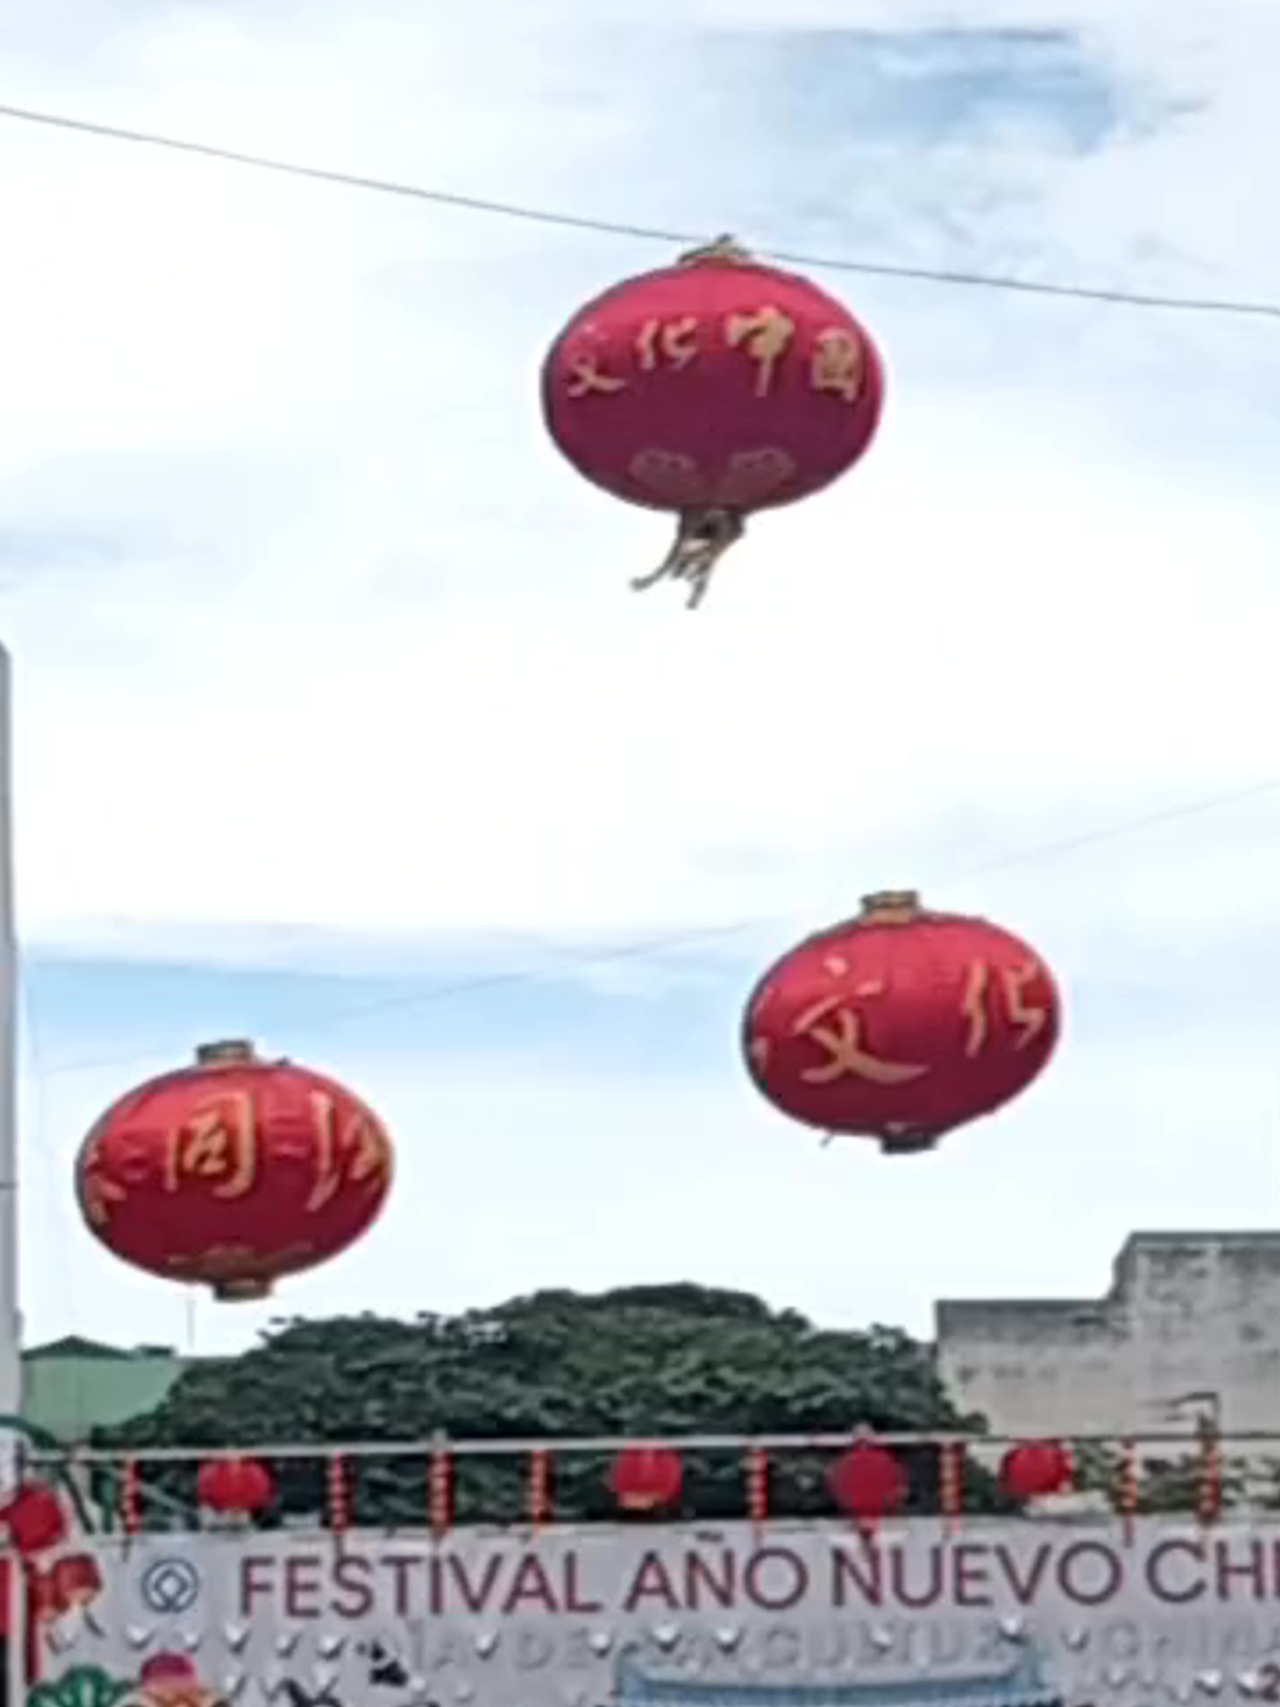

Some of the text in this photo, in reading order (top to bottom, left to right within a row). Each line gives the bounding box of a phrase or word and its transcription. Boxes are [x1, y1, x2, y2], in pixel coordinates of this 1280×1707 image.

[239, 1553, 603, 1621] FESTIVAL
[623, 1532, 811, 1615] AÑO
[831, 1540, 1126, 1609] NUEVO
